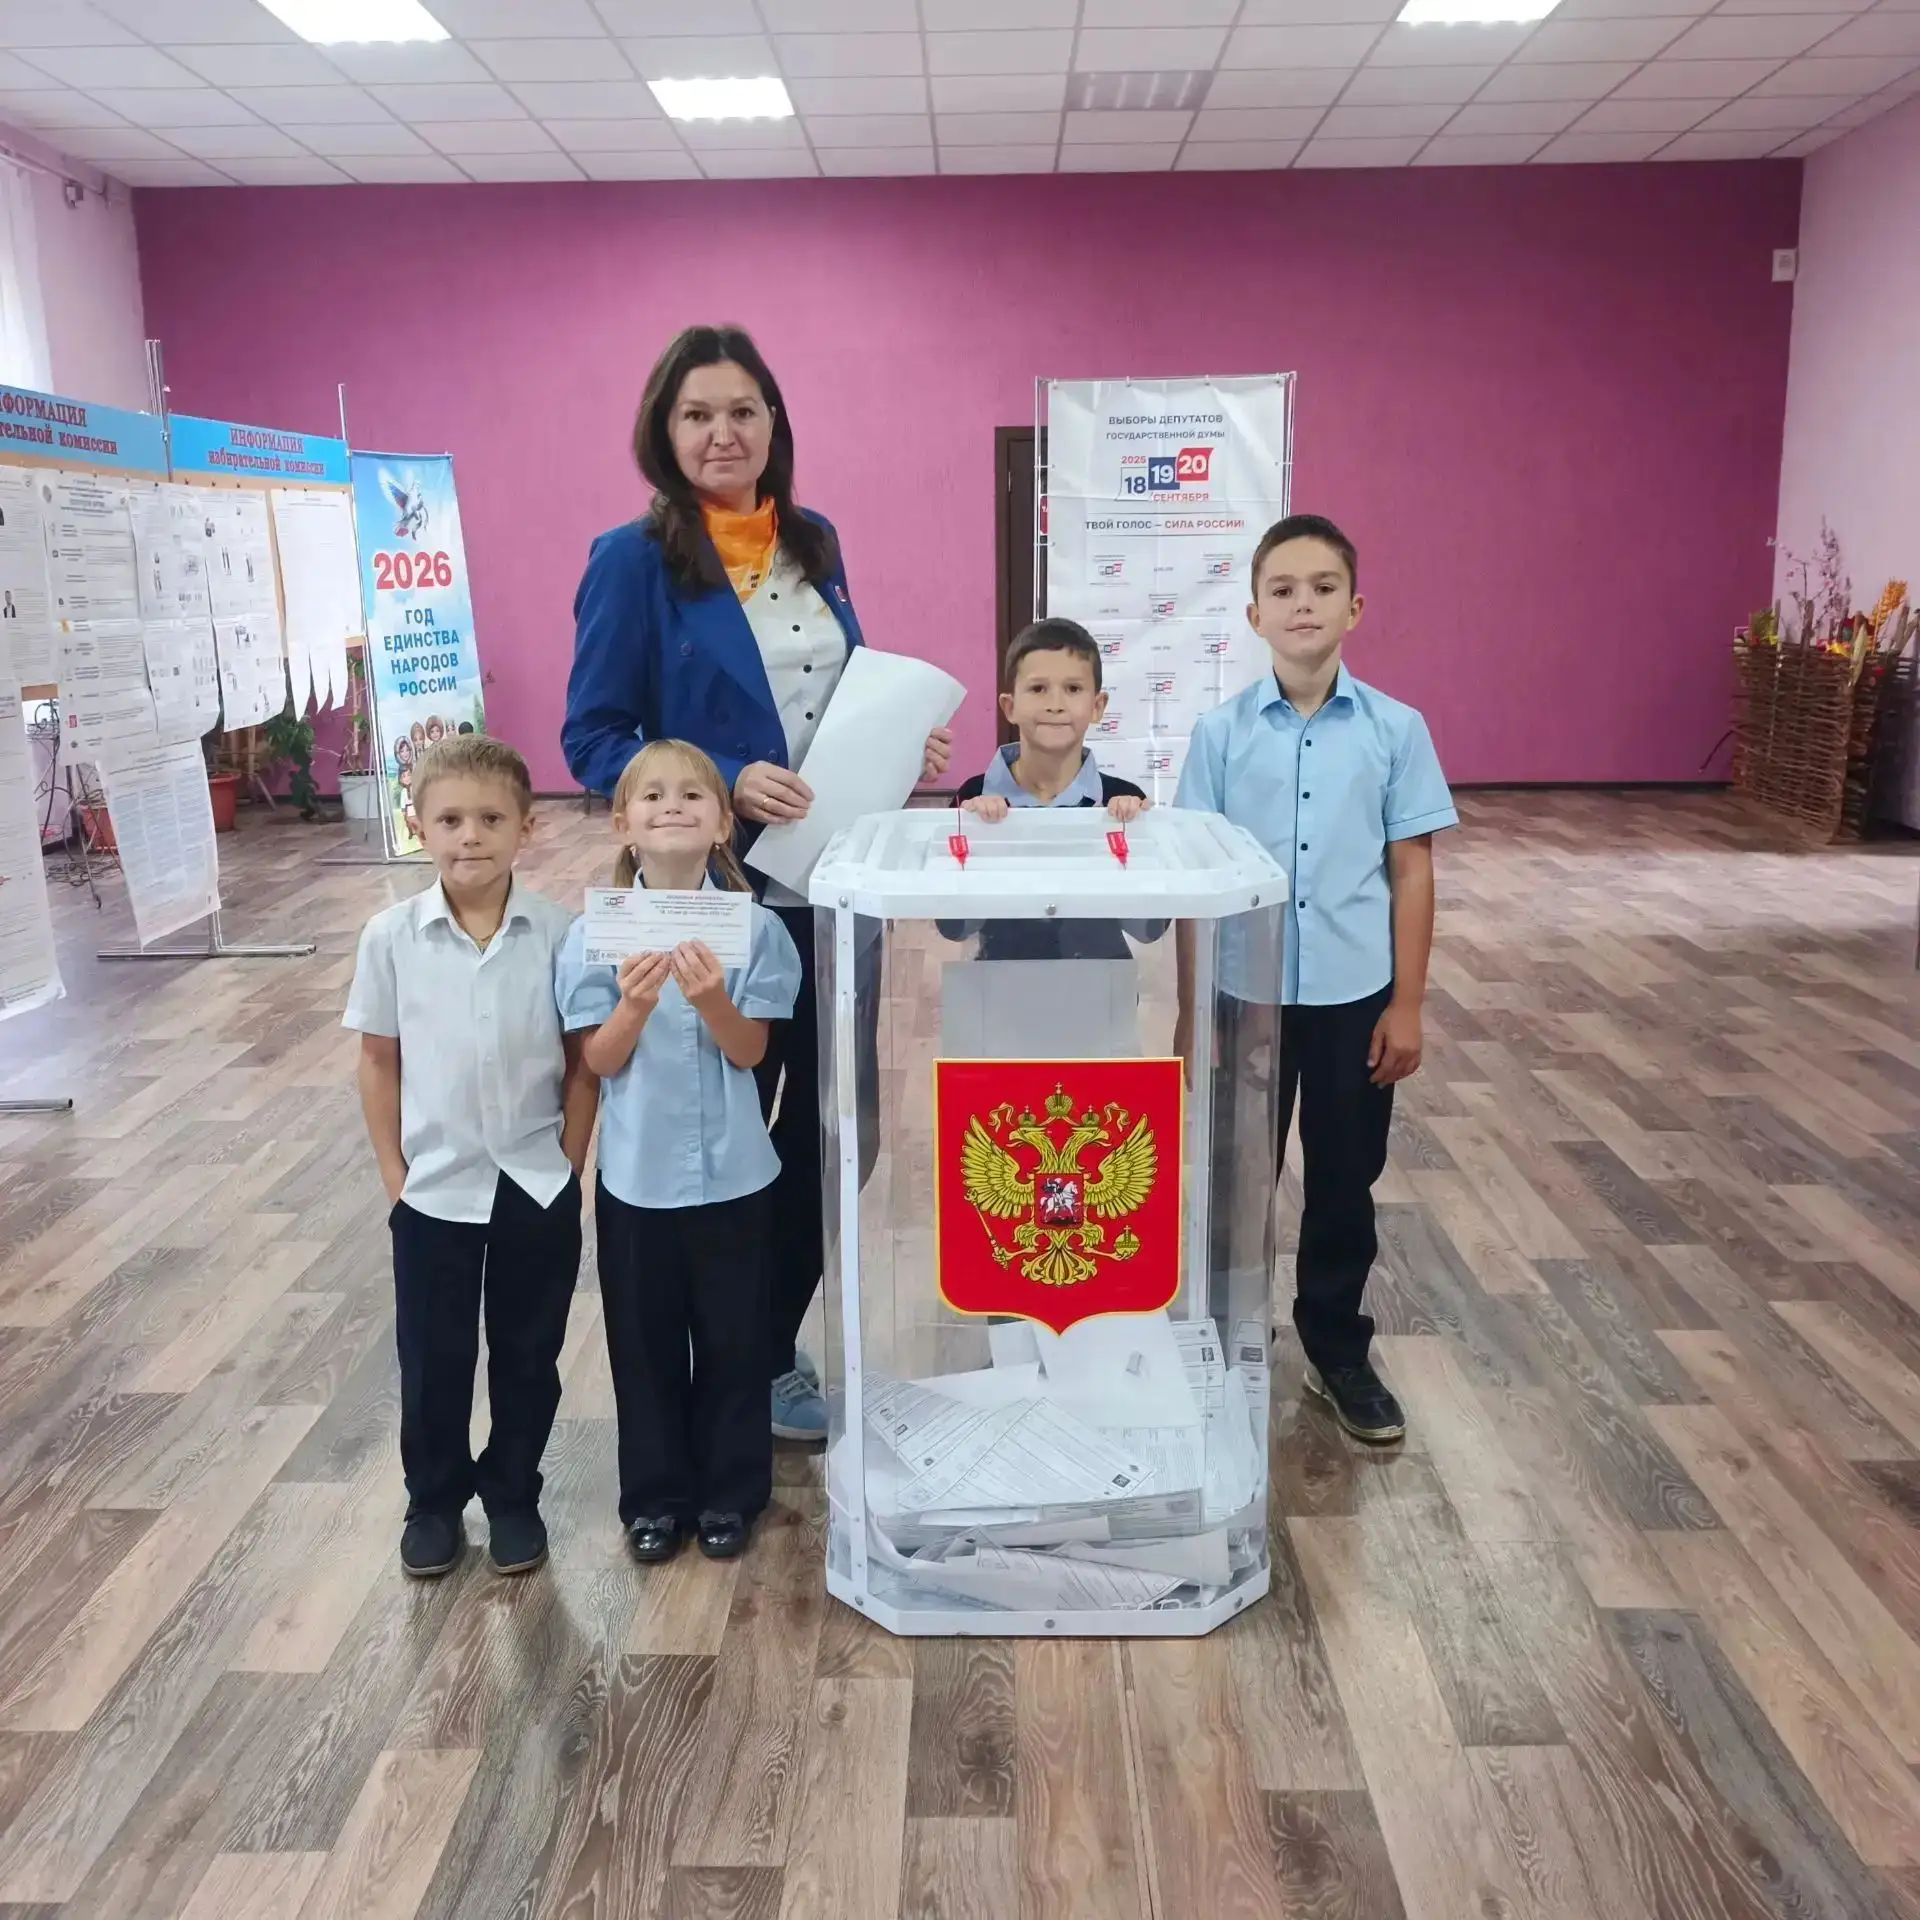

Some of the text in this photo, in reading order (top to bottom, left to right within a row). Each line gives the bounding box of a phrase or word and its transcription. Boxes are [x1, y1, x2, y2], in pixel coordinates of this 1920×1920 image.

[0, 392, 87, 428] ФОРМАЦИЯ
[1108, 414, 1223, 425] ВЫБОРЫ ДЕПУТАТОВ
[230, 428, 304, 456] ИНФОРМАЦИЯ
[1106, 430, 1225, 440] ГОСУДАРСТВЕННОЙ ДУМЫ
[1124, 455, 1207, 494] 18 19 20
[1153, 493, 1209, 502] СЕНТЯБРЯ
[1085, 519, 1113, 529] ТВОЙ
[1116, 520, 1152, 529] ГОЛОС
[1165, 520, 1194, 529] СИЛА
[1197, 519, 1244, 529] РОССИИ!
[374, 551, 452, 589] 2026
[405, 608, 434, 626] ГОД
[384, 630, 460, 652] ЕДИНСТВА
[391, 653, 459, 674] НАРОДОВ
[399, 676, 457, 697] РОССИИ
